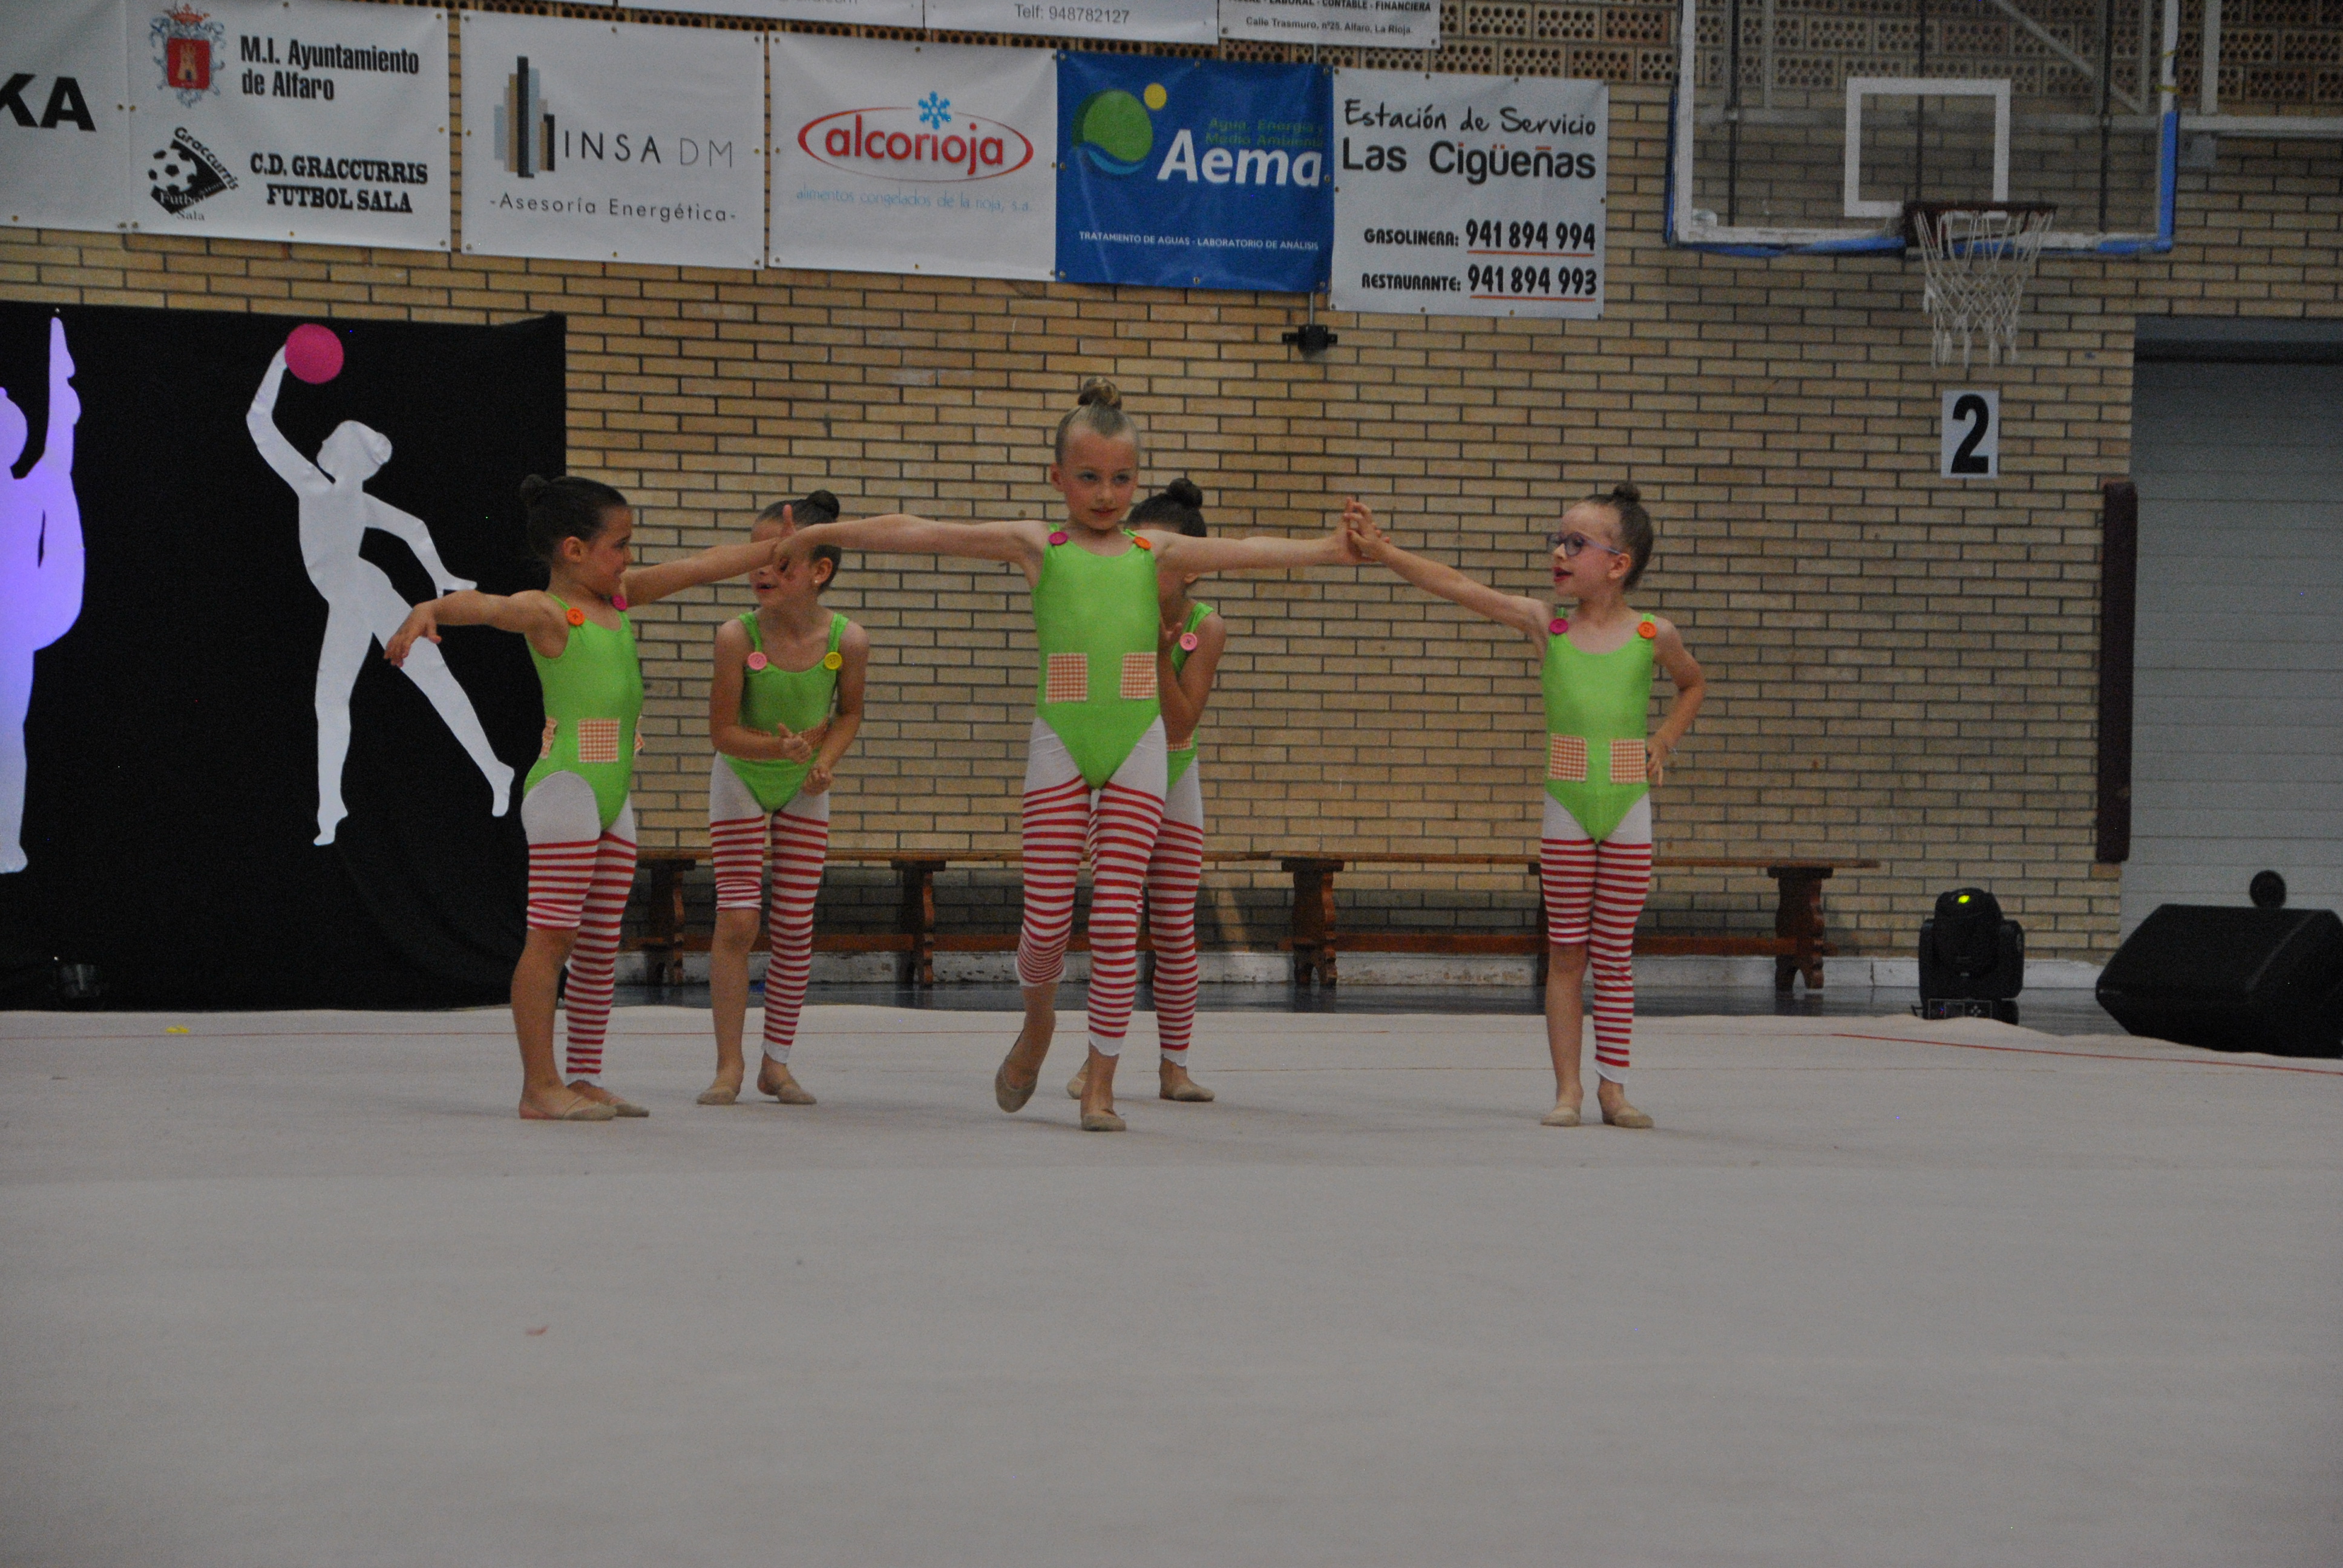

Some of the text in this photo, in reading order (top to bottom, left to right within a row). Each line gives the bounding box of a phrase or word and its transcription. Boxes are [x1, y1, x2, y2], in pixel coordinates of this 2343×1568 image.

[1015, 4, 1130, 24] Telf: 948782127
[1322, 0, 1368, 10] CONTABLE
[1375, 1, 1431, 11] FINANCIERA
[1246, 16, 1269, 26] Calle
[1375, 25, 1386, 33] La
[240, 35, 420, 74] M.I. Ayuntamiento
[241, 68, 335, 101] de Alfaro
[1344, 98, 1596, 136] Estación de Servicio
[564, 129, 733, 168] INSA DM
[825, 114, 1003, 175] alcorioja
[1156, 128, 1322, 188] Aema
[1342, 136, 1597, 185] Las Cigüeñas
[250, 152, 428, 185] C.D. GRACCURRIS
[266, 183, 413, 214] FUTBOL SALA
[796, 184, 854, 203] alimentos
[860, 187, 931, 209] congelados
[937, 191, 955, 208] de
[960, 192, 970, 209] la
[1079, 231, 1319, 251] TRATAMIENTO DE AGUAS LABORATORIO DE ANÁLISIS
[1363, 218, 1596, 251] GASOLINERA: 941 894 994
[1362, 264, 1597, 295] RESTAURANTE: 941 894 993
[1951, 394, 1989, 474] 2
